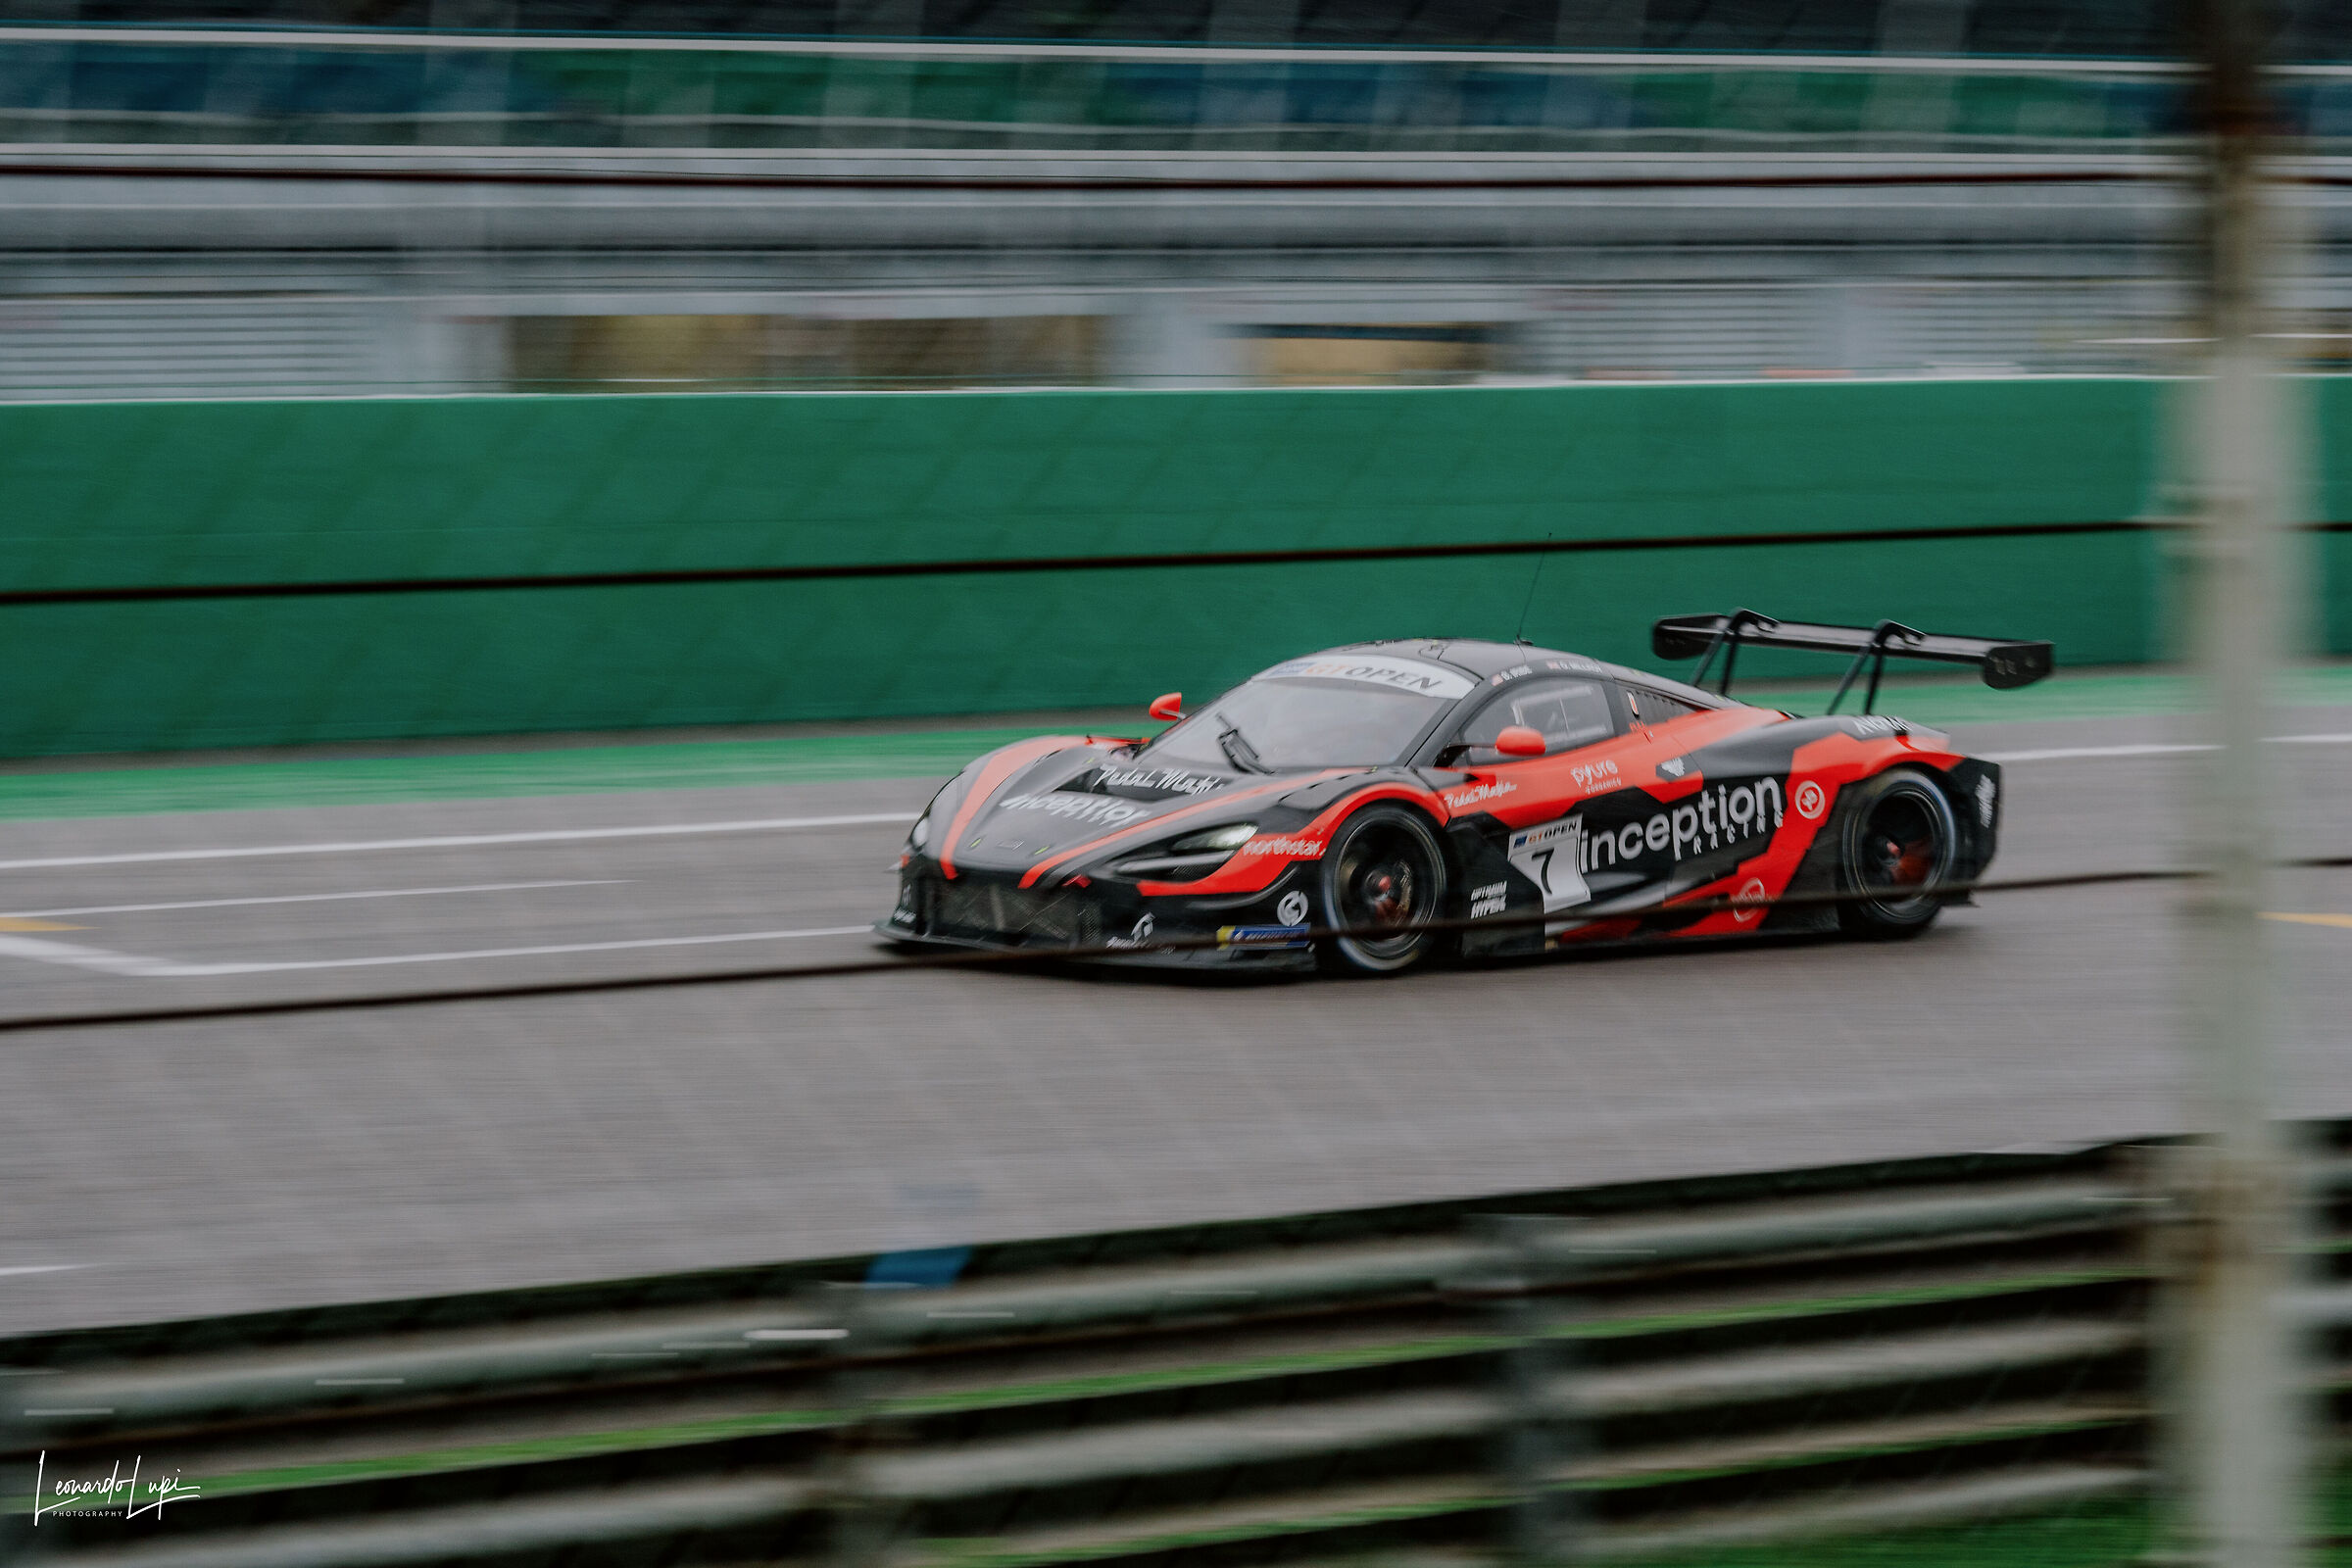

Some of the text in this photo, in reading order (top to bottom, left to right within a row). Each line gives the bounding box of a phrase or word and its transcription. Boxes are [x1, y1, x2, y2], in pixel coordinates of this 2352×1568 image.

[1580, 776, 1785, 874] inception
[1692, 807, 1785, 856] RACING
[1531, 847, 1555, 896] 7
